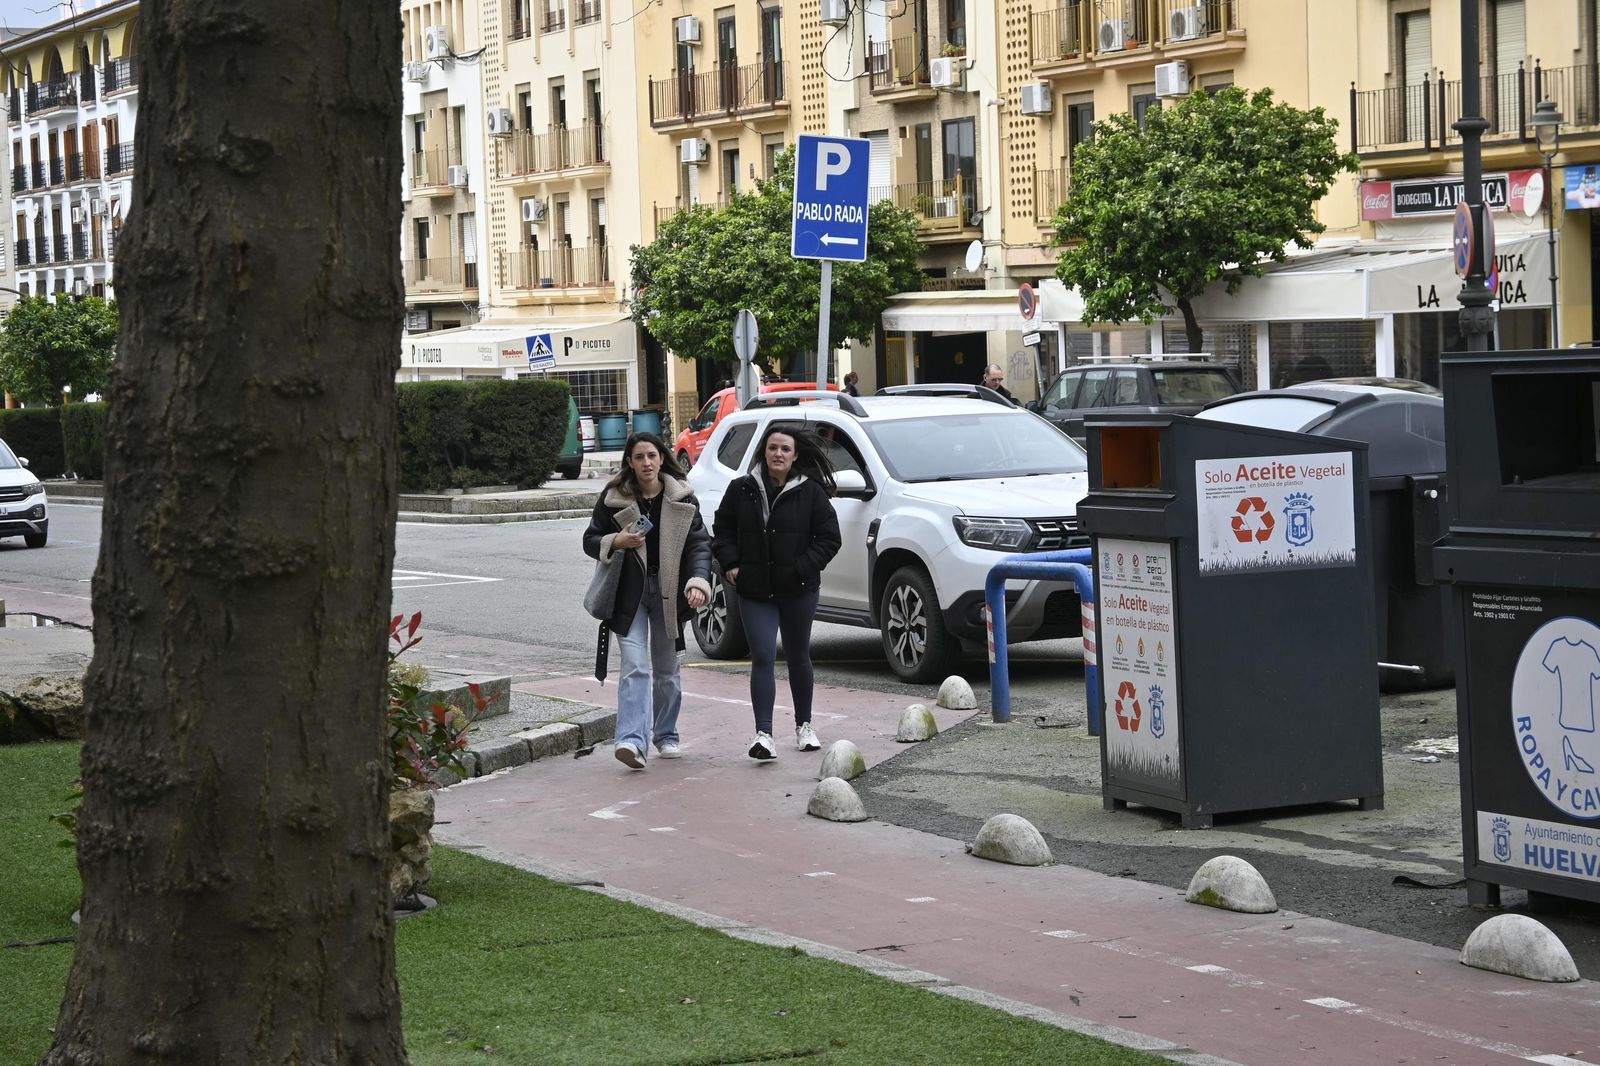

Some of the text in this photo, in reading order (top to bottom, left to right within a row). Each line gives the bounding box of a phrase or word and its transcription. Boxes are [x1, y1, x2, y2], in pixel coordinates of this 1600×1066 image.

[815, 141, 852, 191] P
[1397, 192, 1432, 206] BODEGUITA
[1434, 184, 1451, 207] LA
[796, 202, 864, 223] PABLO RADA
[1417, 284, 1440, 309] LA
[422, 348, 442, 363] PICOTEO
[563, 336, 574, 357] P
[582, 339, 611, 349] PICOTEO
[1204, 461, 1346, 484] Solo Aceite Vegetal
[1145, 555, 1157, 564] pre
[1146, 565, 1162, 575] zero
[1104, 593, 1170, 616] Solo Aceite Vegetal
[1472, 602, 1500, 610] Responsables
[1106, 615, 1170, 633] en botella de plástico
[1517, 716, 1551, 790] ROPA
[1556, 779, 1568, 801] Y
[1525, 823, 1594, 846] Ayuntamiento
